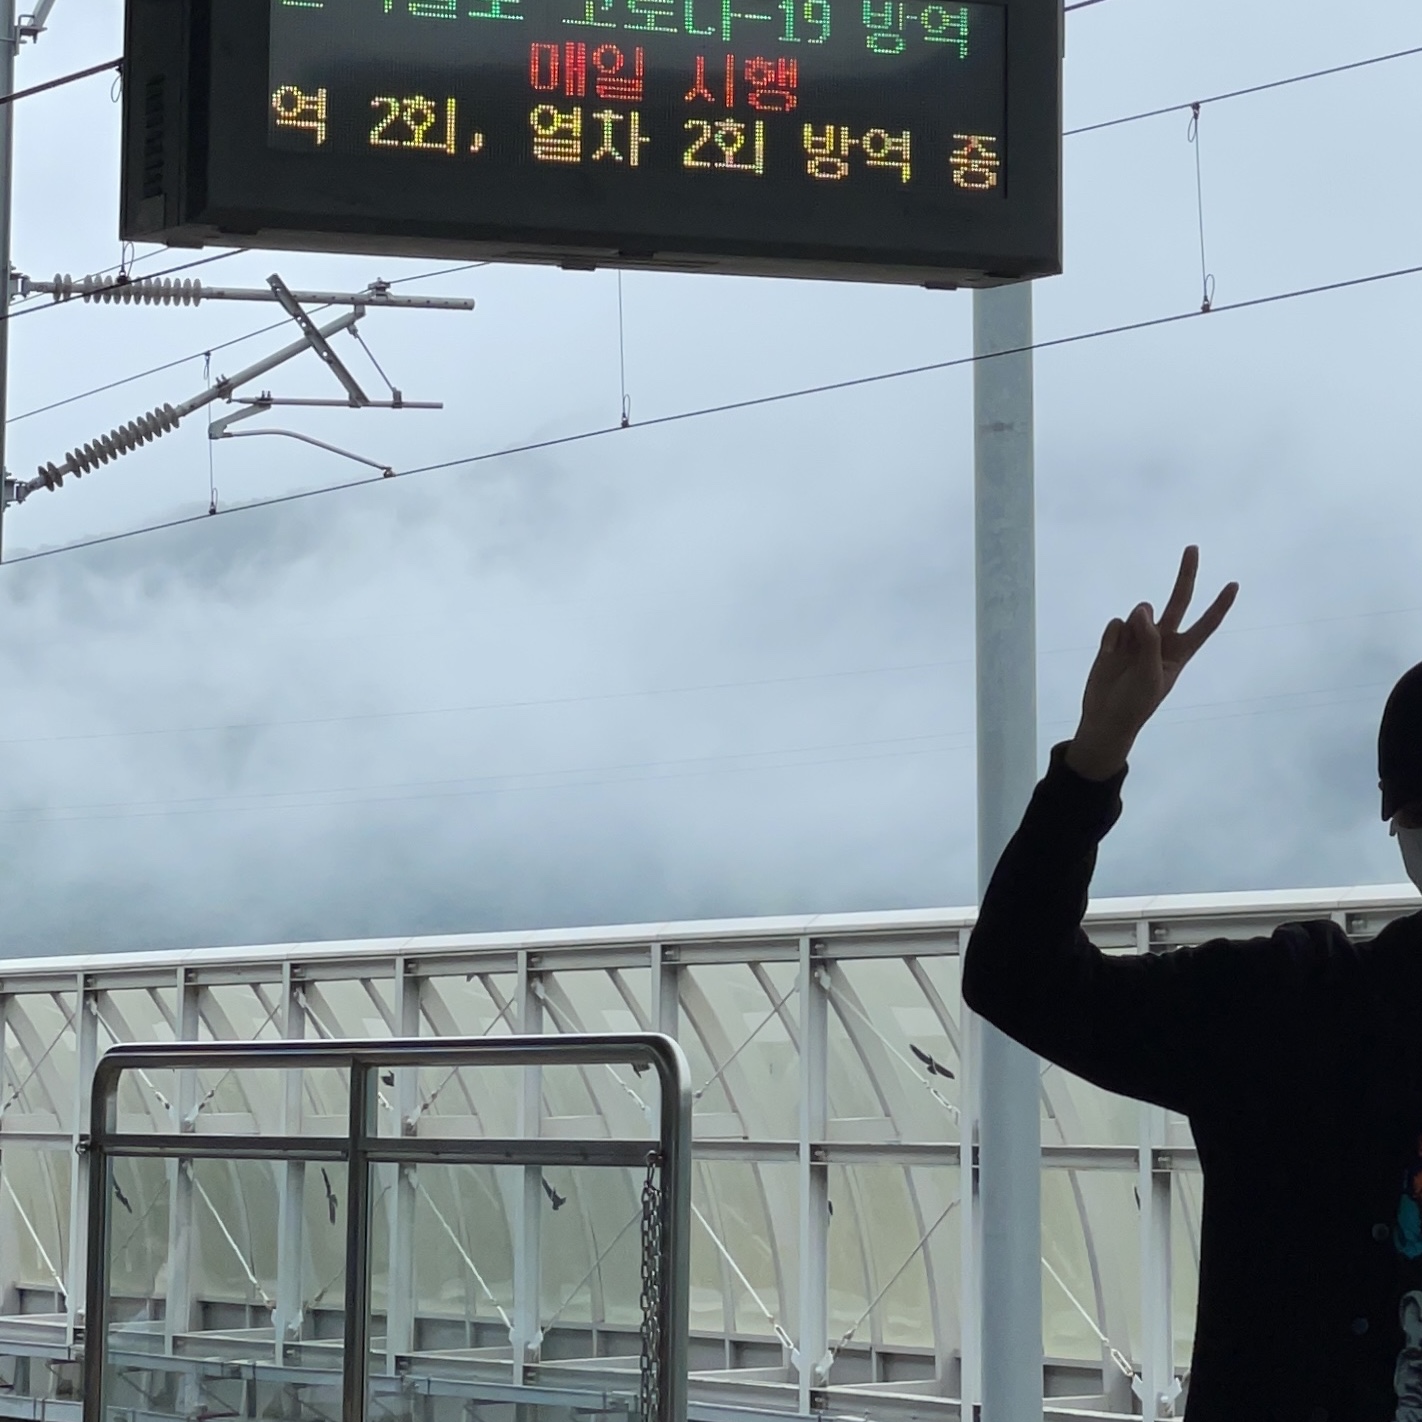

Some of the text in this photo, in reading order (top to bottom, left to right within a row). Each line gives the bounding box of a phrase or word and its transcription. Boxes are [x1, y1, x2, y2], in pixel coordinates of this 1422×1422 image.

[862, 0, 969, 59] 방역
[529, 41, 798, 112] 매일 시행
[271, 85, 1000, 189] 역 2회, 열차 2회 방역 중
